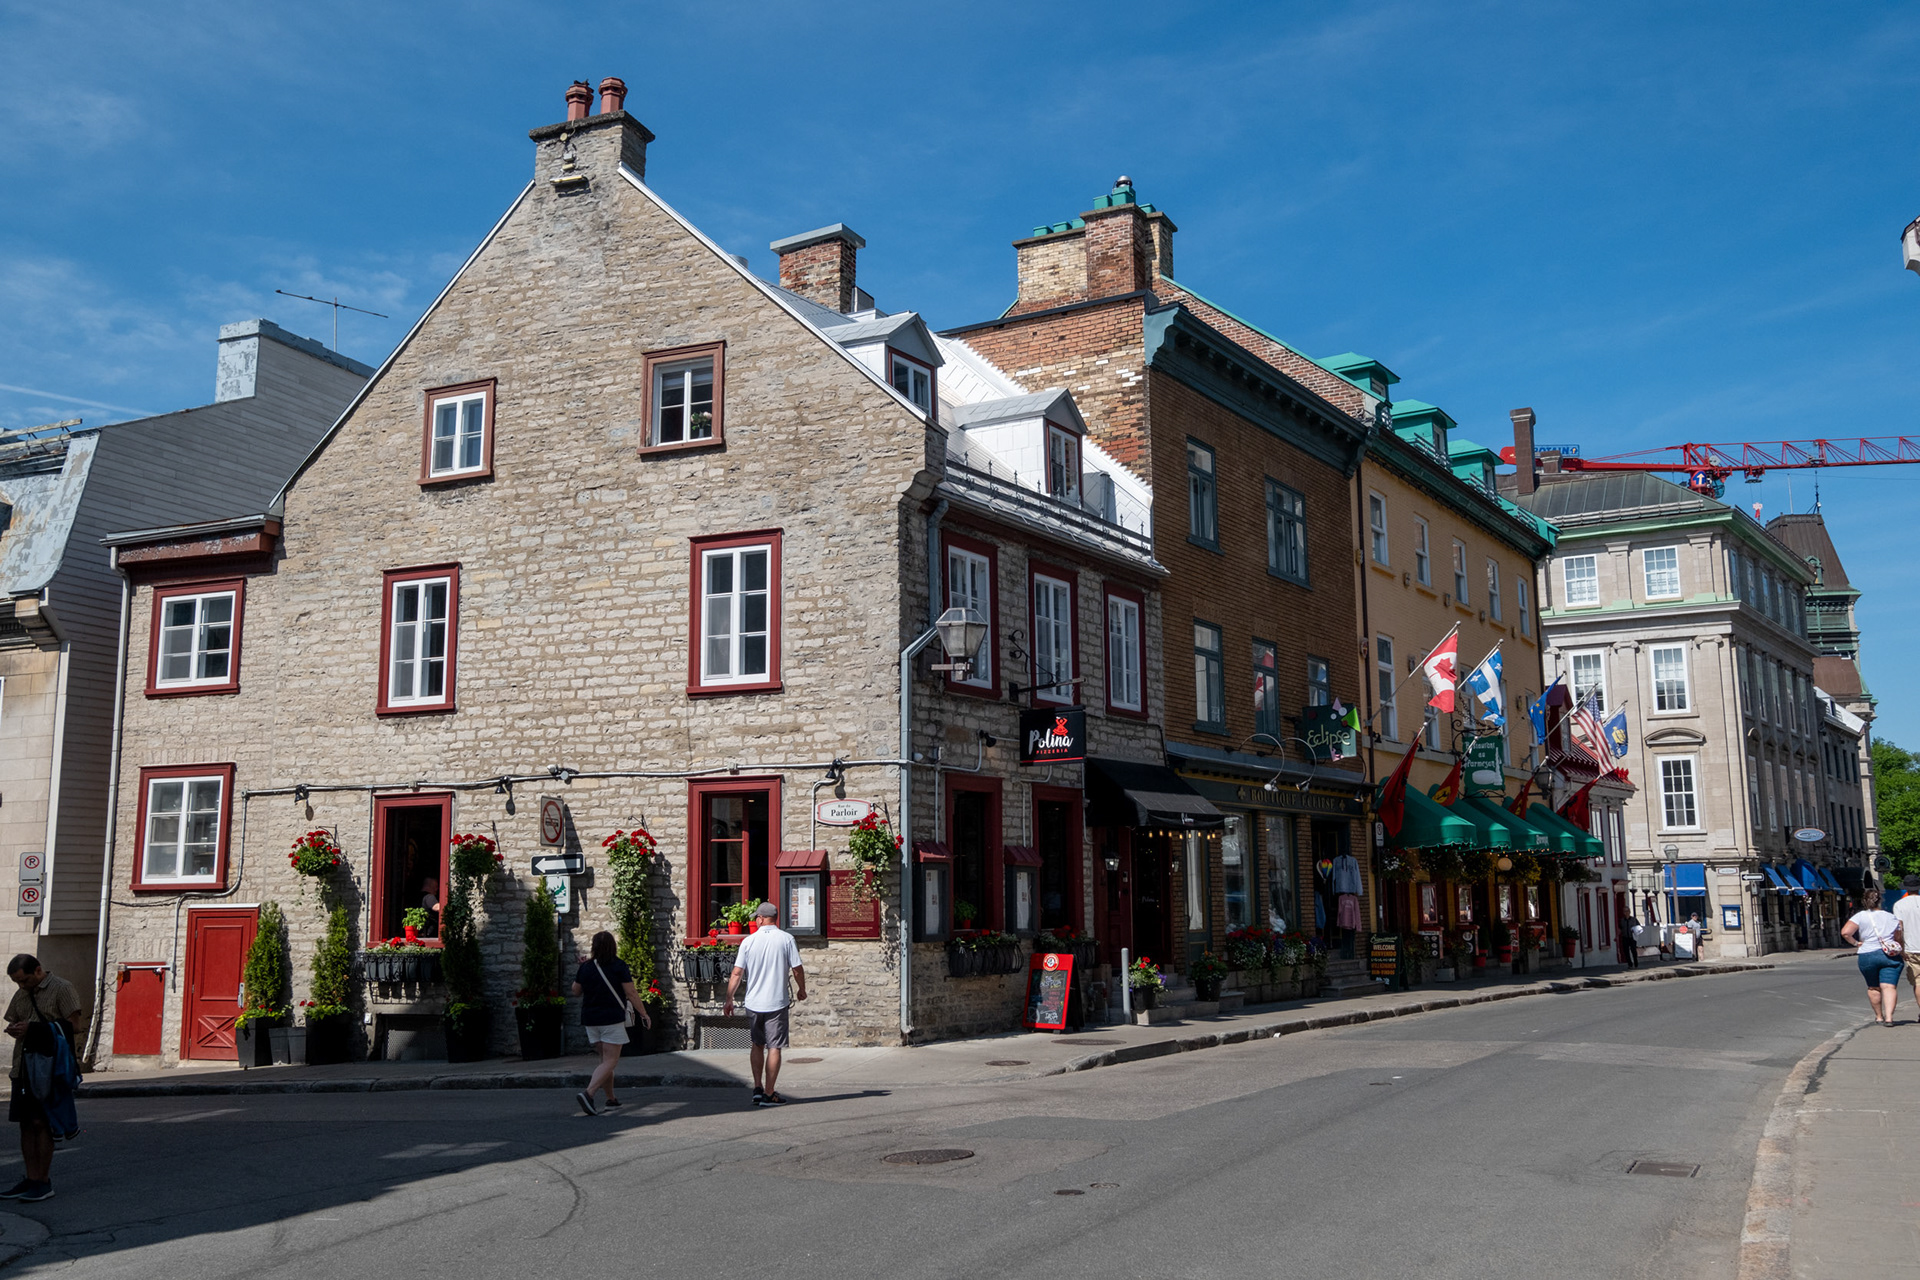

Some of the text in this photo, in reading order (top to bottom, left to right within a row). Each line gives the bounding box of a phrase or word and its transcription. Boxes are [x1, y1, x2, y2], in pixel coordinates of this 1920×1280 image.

[1028, 728, 1073, 755] Polina
[1307, 724, 1351, 752] Eclipse
[1465, 741, 1495, 750] Rstaurant
[1251, 789, 1297, 807] BOUTIQUE
[831, 808, 858, 817] Parloir
